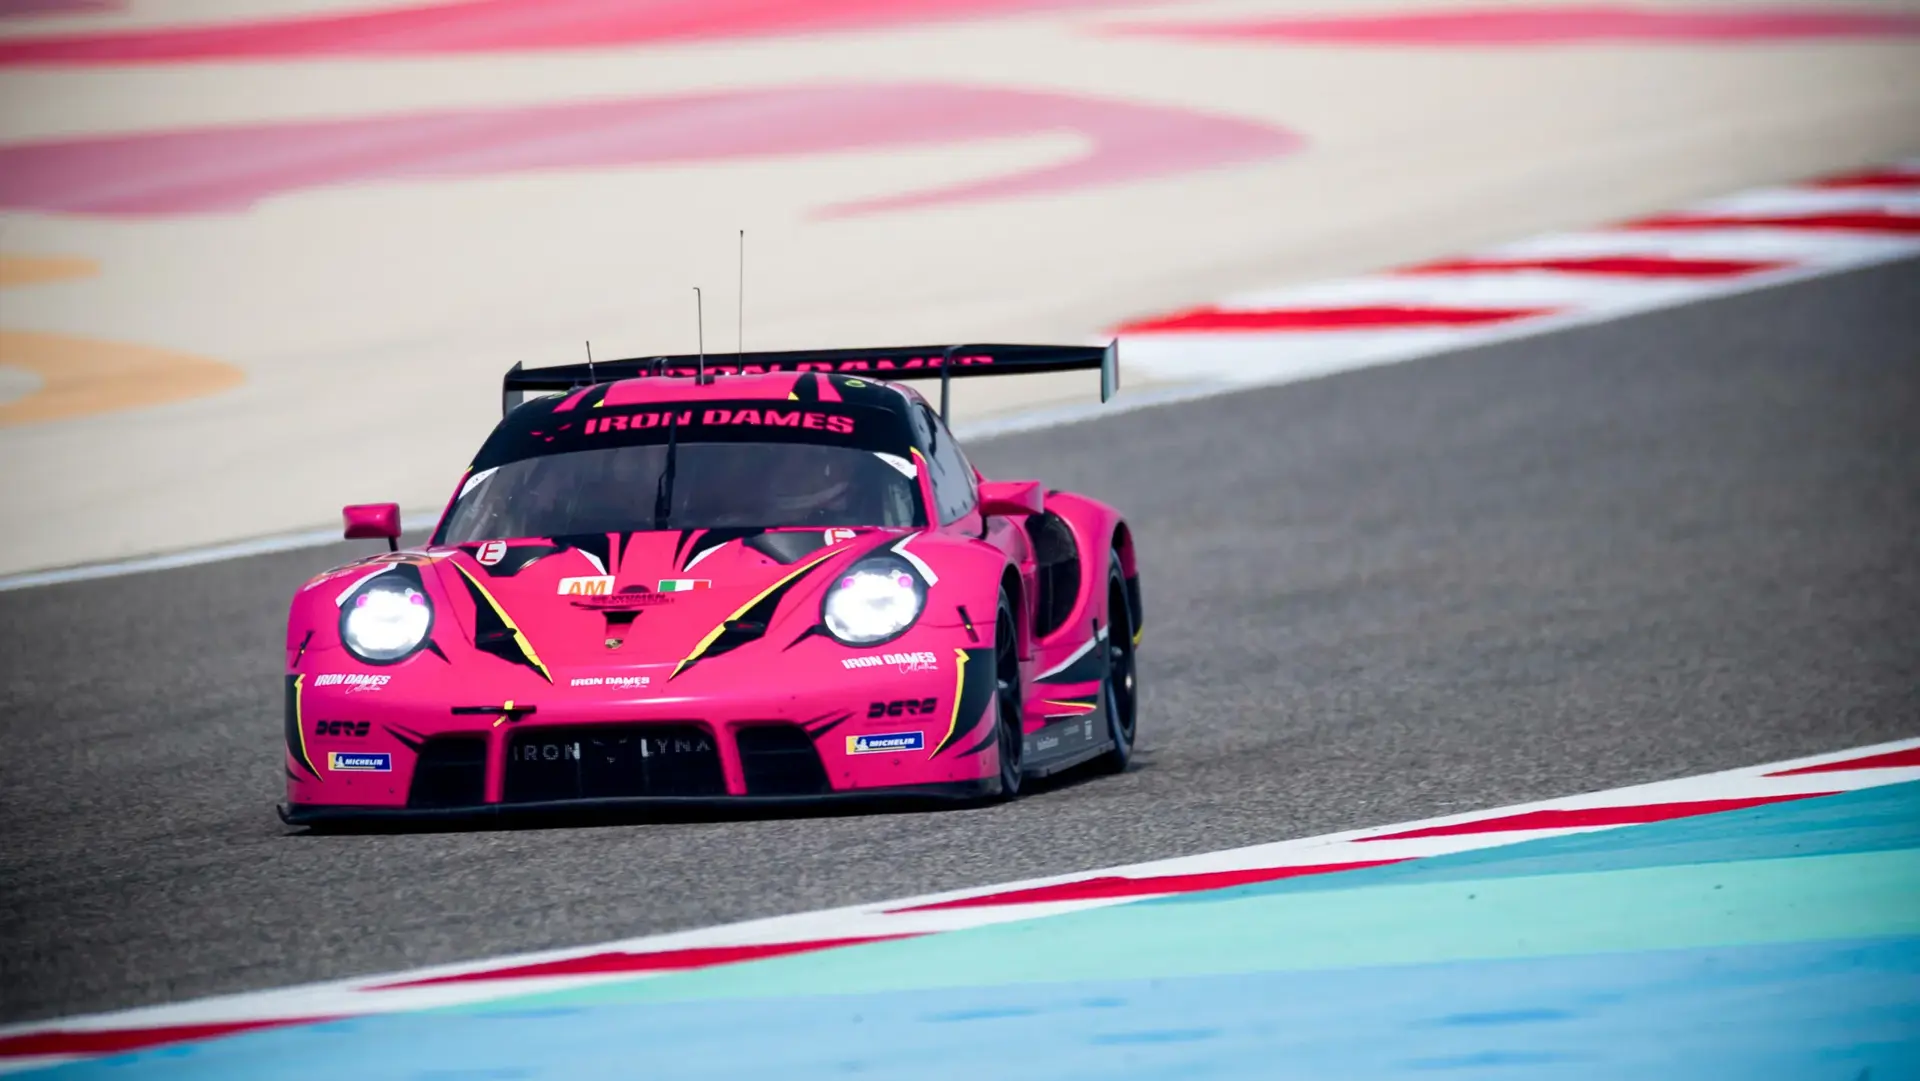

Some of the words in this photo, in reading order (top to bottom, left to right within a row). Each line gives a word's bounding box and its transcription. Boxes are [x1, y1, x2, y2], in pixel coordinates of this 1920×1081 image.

[584, 410, 692, 435] IRON
[702, 409, 855, 434] DAMES
[480, 541, 502, 563] E
[568, 580, 607, 595] AM
[841, 655, 884, 669] IRON
[882, 651, 937, 665] DAMES
[314, 674, 346, 686] IRON
[344, 674, 391, 685] DAMES
[570, 677, 603, 687] IRON
[605, 676, 650, 685] DAMES
[869, 737, 915, 747] MICHELIN
[513, 742, 580, 761] IRON
[345, 758, 384, 766] MICHELIN
